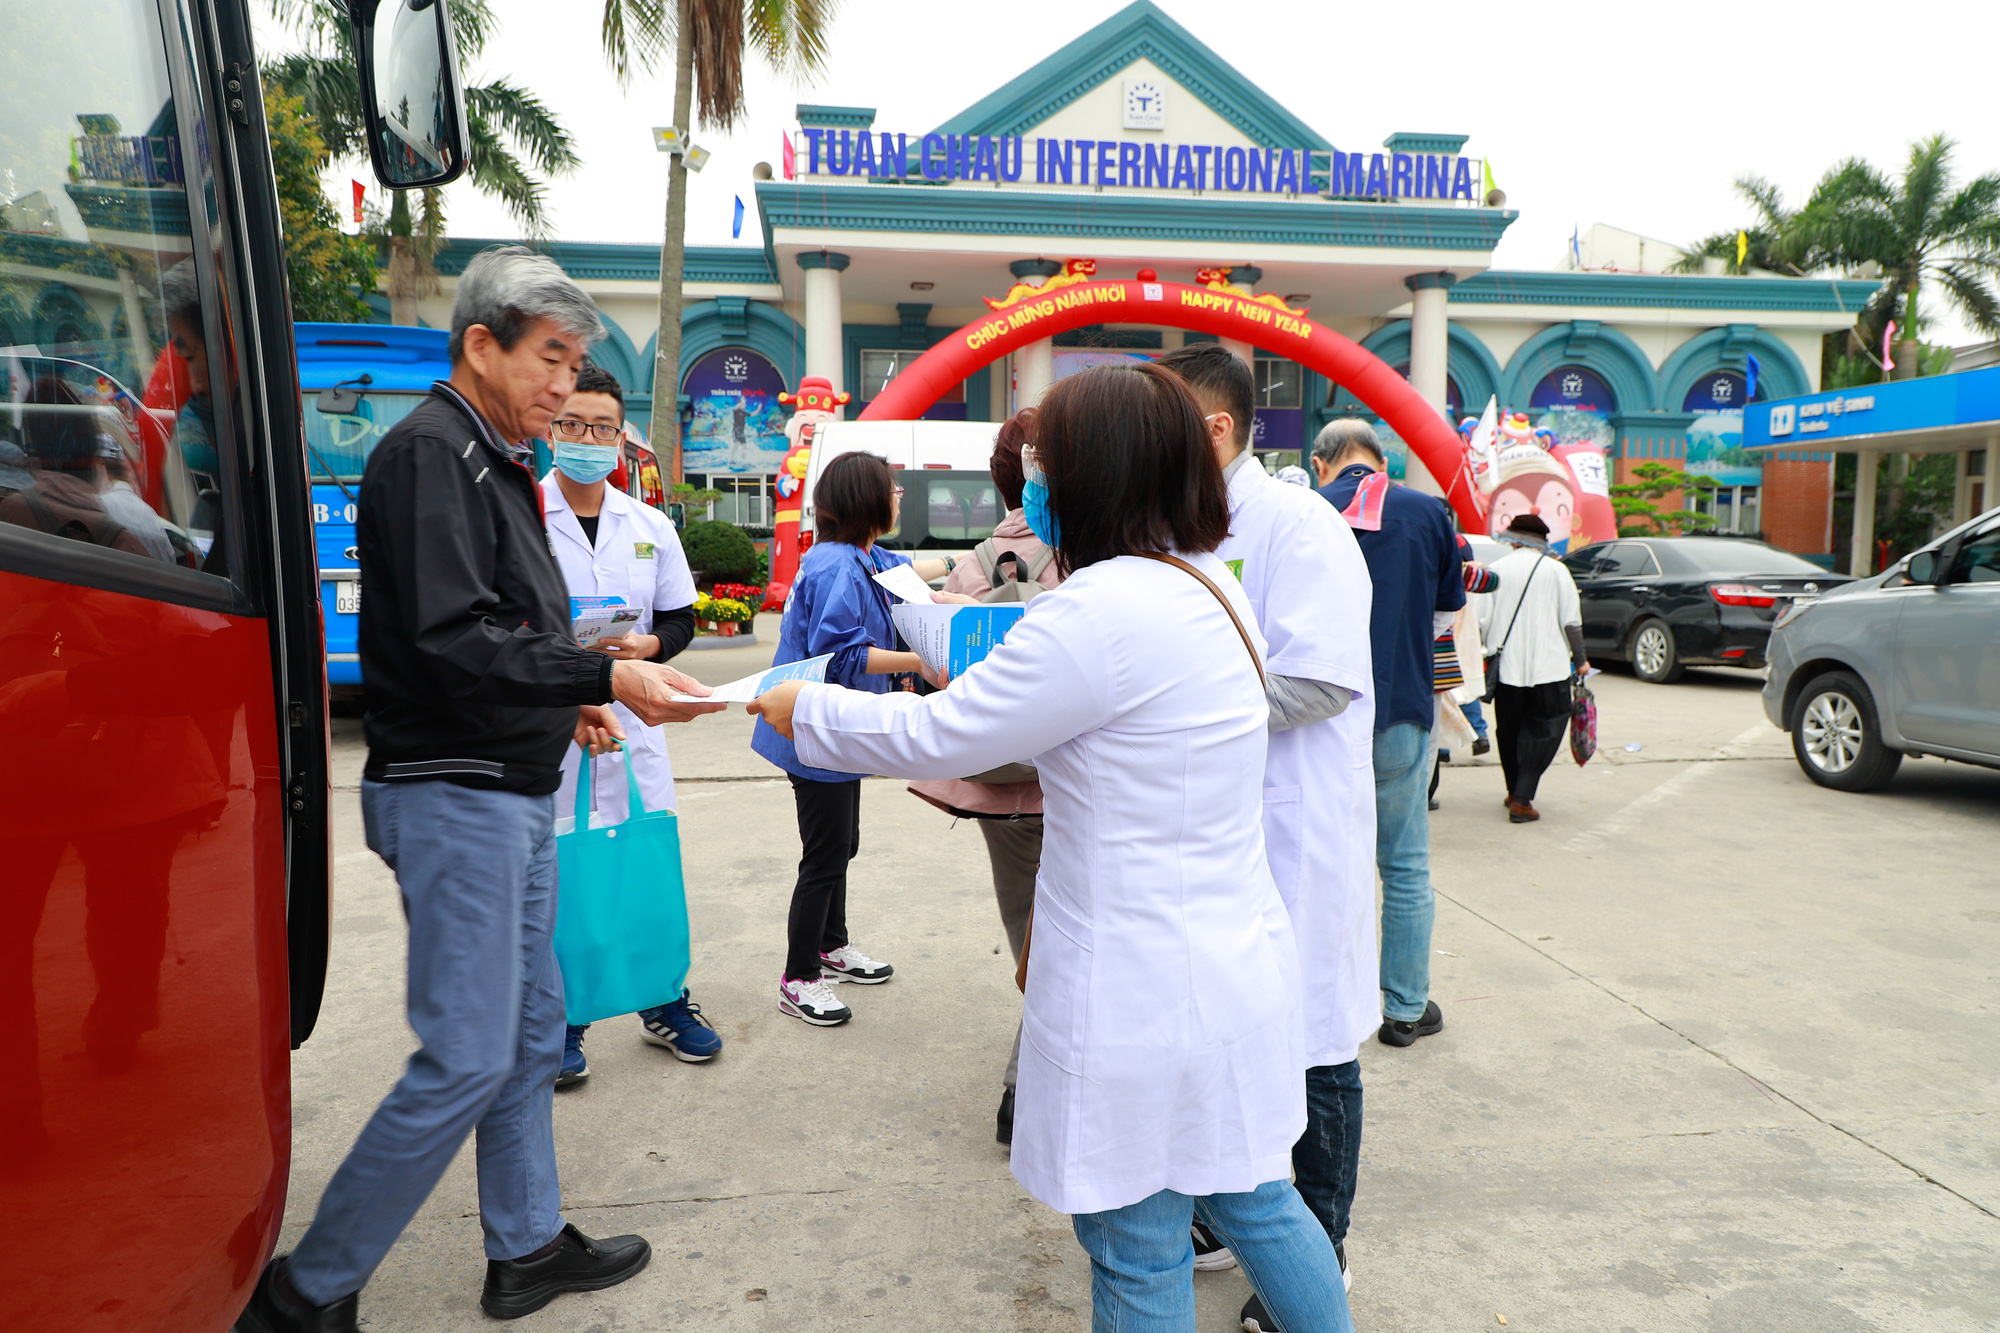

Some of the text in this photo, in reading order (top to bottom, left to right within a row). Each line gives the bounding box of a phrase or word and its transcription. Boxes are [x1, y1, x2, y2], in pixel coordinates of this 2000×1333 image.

[804, 129, 1473, 200] TUAN CHAU INTERNATIONAL MARINA
[966, 319, 1009, 350] CHÚC
[1181, 289, 1313, 339] HAPPY NEW YEAR
